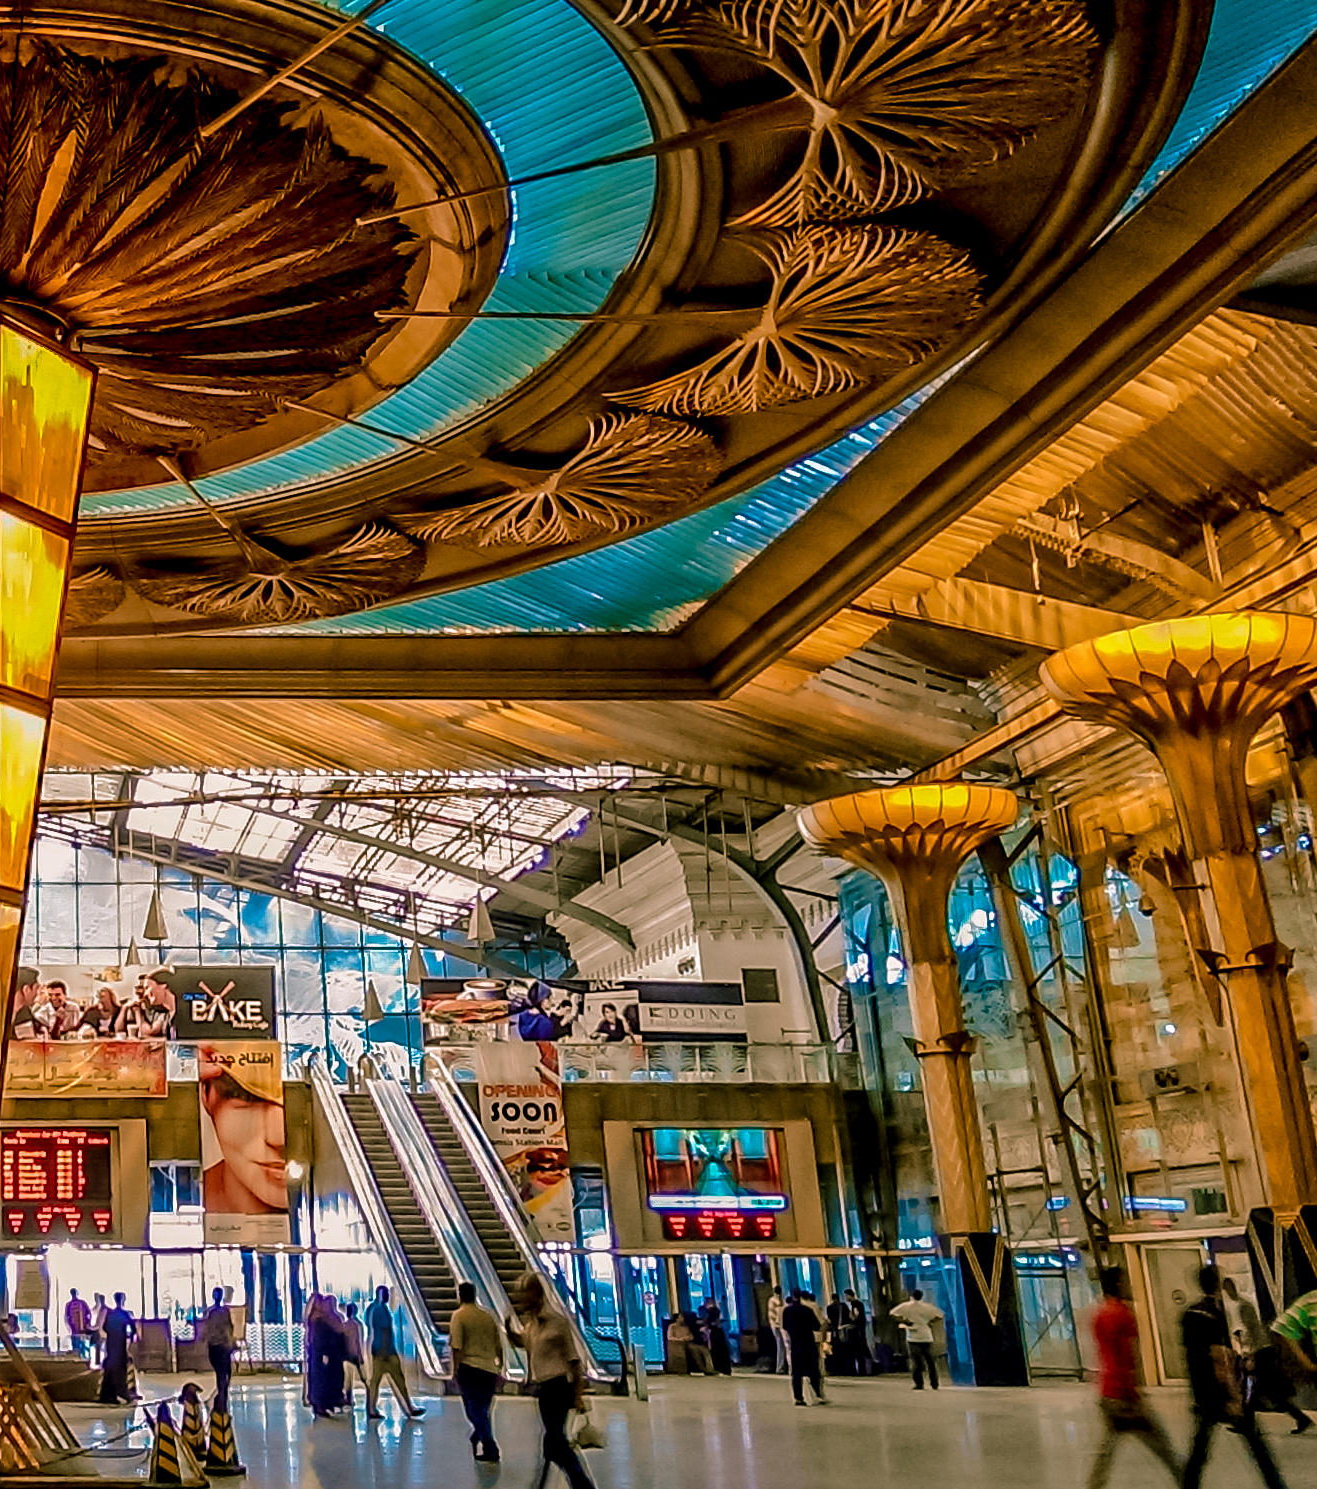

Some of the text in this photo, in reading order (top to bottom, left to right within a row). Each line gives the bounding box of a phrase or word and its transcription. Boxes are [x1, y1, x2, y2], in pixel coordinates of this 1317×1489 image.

[192, 997, 262, 1021] BAKE
[669, 1007, 736, 1020] DOING
[483, 1084, 558, 1098] OPENING
[490, 1101, 557, 1122] SOON
